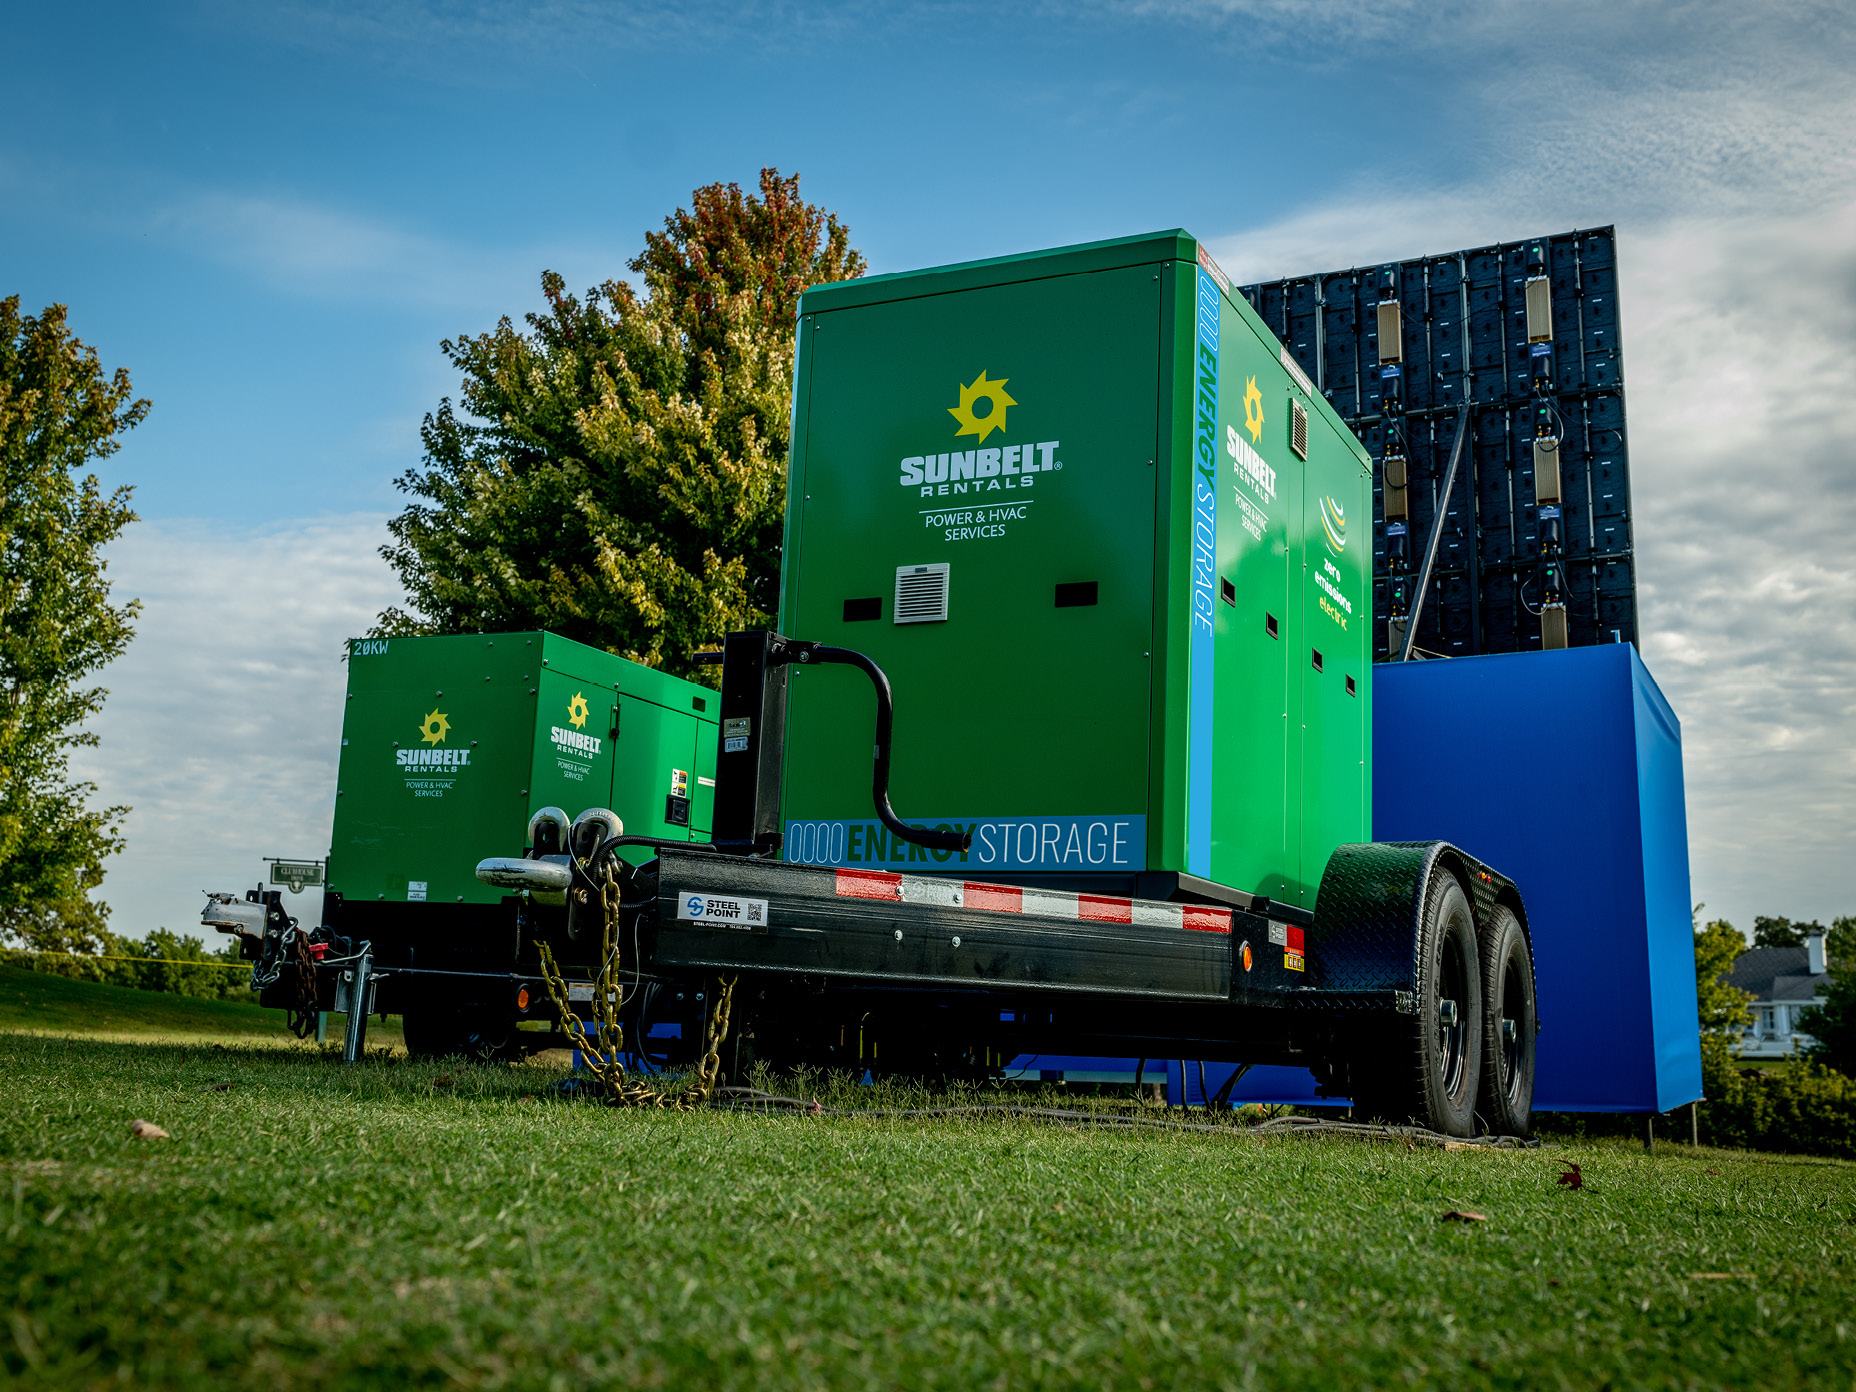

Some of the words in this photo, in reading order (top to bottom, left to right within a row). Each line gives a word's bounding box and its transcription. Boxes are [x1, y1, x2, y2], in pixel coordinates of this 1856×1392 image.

[1198, 342, 1216, 493] ENERGY
[920, 475, 1034, 498] RENTALS
[1233, 461, 1269, 505] RENTALS
[925, 510, 974, 528] POWER
[975, 509, 986, 523] &
[988, 506, 1027, 521] HVAC
[1235, 493, 1252, 518] POWER
[1255, 511, 1268, 533] HVAC
[944, 524, 1006, 541] SERVICES
[1241, 514, 1261, 541] SERVICES
[1195, 484, 1214, 637] STORAGE
[1324, 558, 1341, 583] zero
[1314, 571, 1352, 614] emissions
[1319, 597, 1347, 631] electric
[557, 744, 593, 760] RENTALS
[404, 765, 458, 773] RENTALS
[558, 761, 574, 772] POWER
[577, 766, 590, 775] HVAC
[563, 770, 583, 781] SERVICES
[978, 822, 1129, 864] STORAGE
[706, 899, 741, 910] STEEL
[706, 908, 741, 918] POINT
